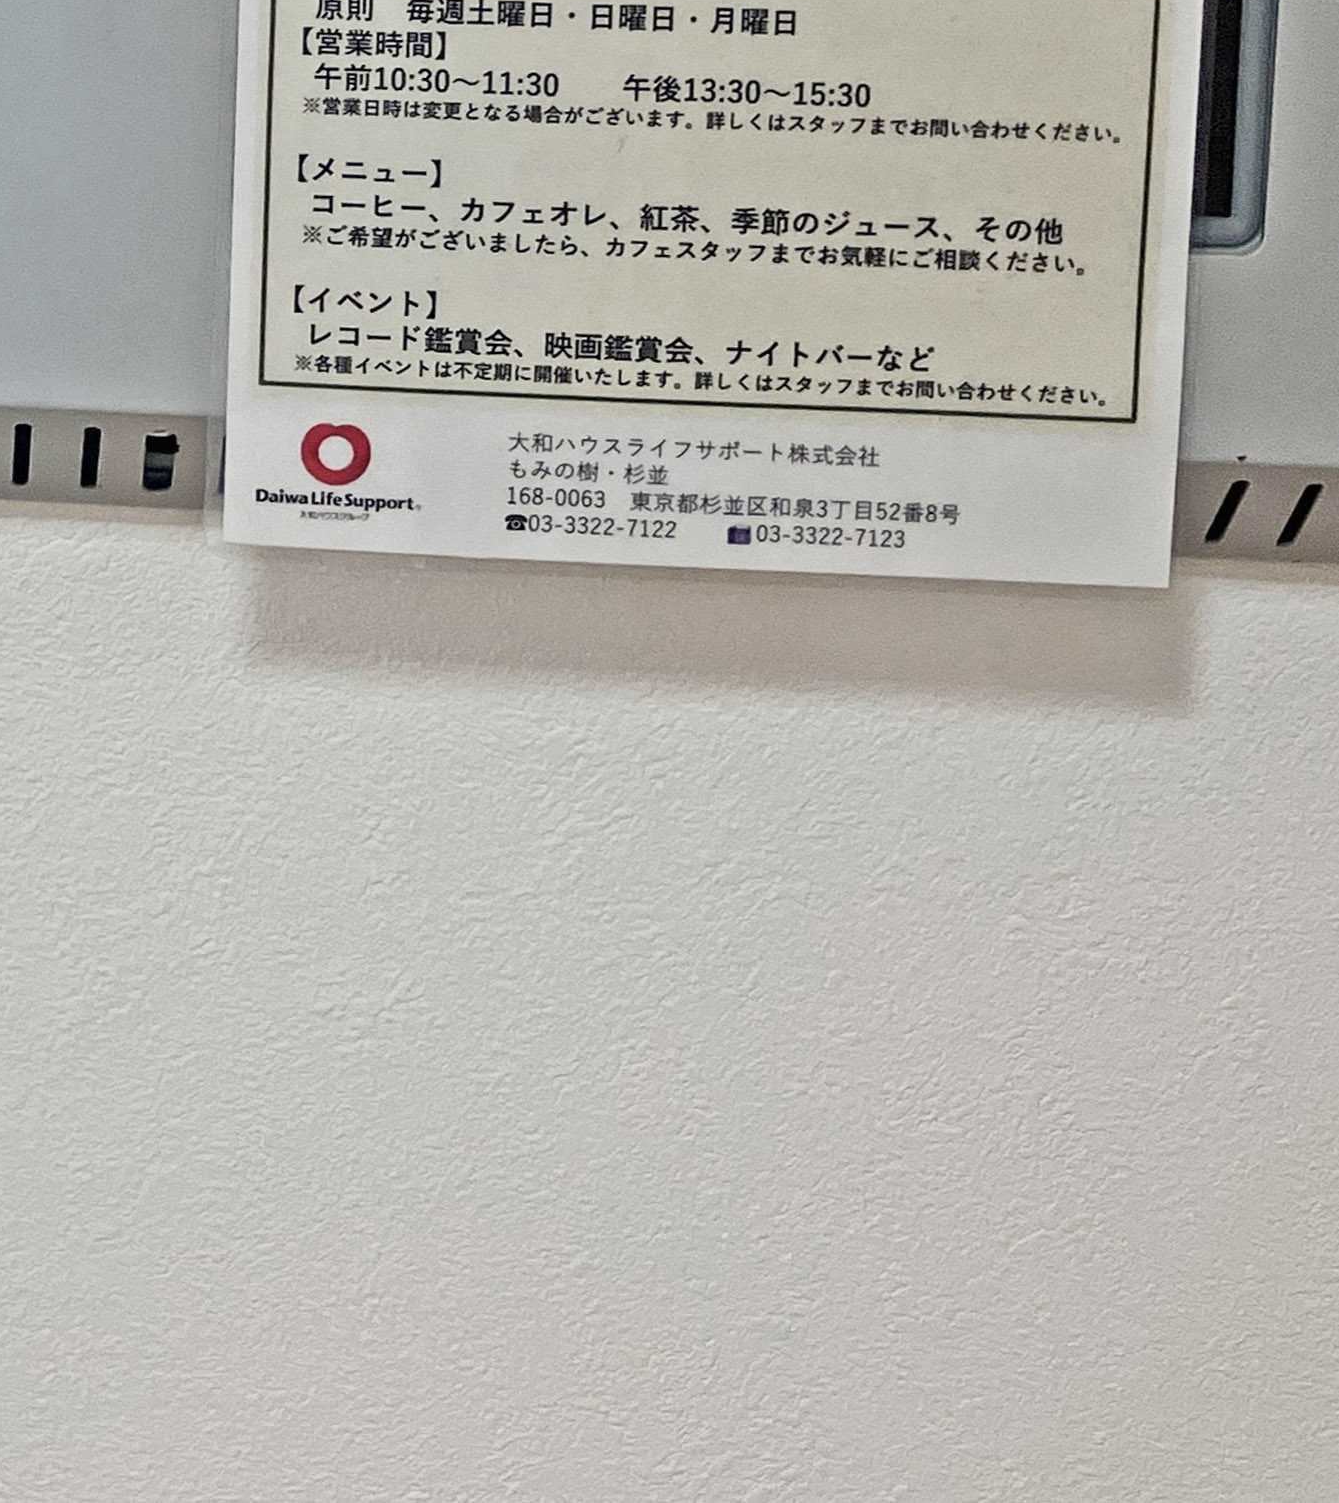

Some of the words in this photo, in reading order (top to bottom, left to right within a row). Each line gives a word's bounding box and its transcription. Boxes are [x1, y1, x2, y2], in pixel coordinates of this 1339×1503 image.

[302, 26, 446, 60] 【営業時間】
[298, 154, 442, 188] 【メニュー】
[293, 284, 438, 319] 【イベント】
[508, 431, 880, 468] 大和ハウスライフサポート株式会社
[510, 459, 669, 486] もみの樹・杉並
[255, 488, 309, 504] Daiwa
[311, 491, 343, 507] Life
[344, 493, 415, 512] Support
[507, 486, 606, 509] 168-0063
[631, 490, 961, 524] 東京都杉並区和泉3丁目52番8号
[528, 514, 677, 539] 03-3322-7122
[756, 525, 906, 549] 03-3322-7123
